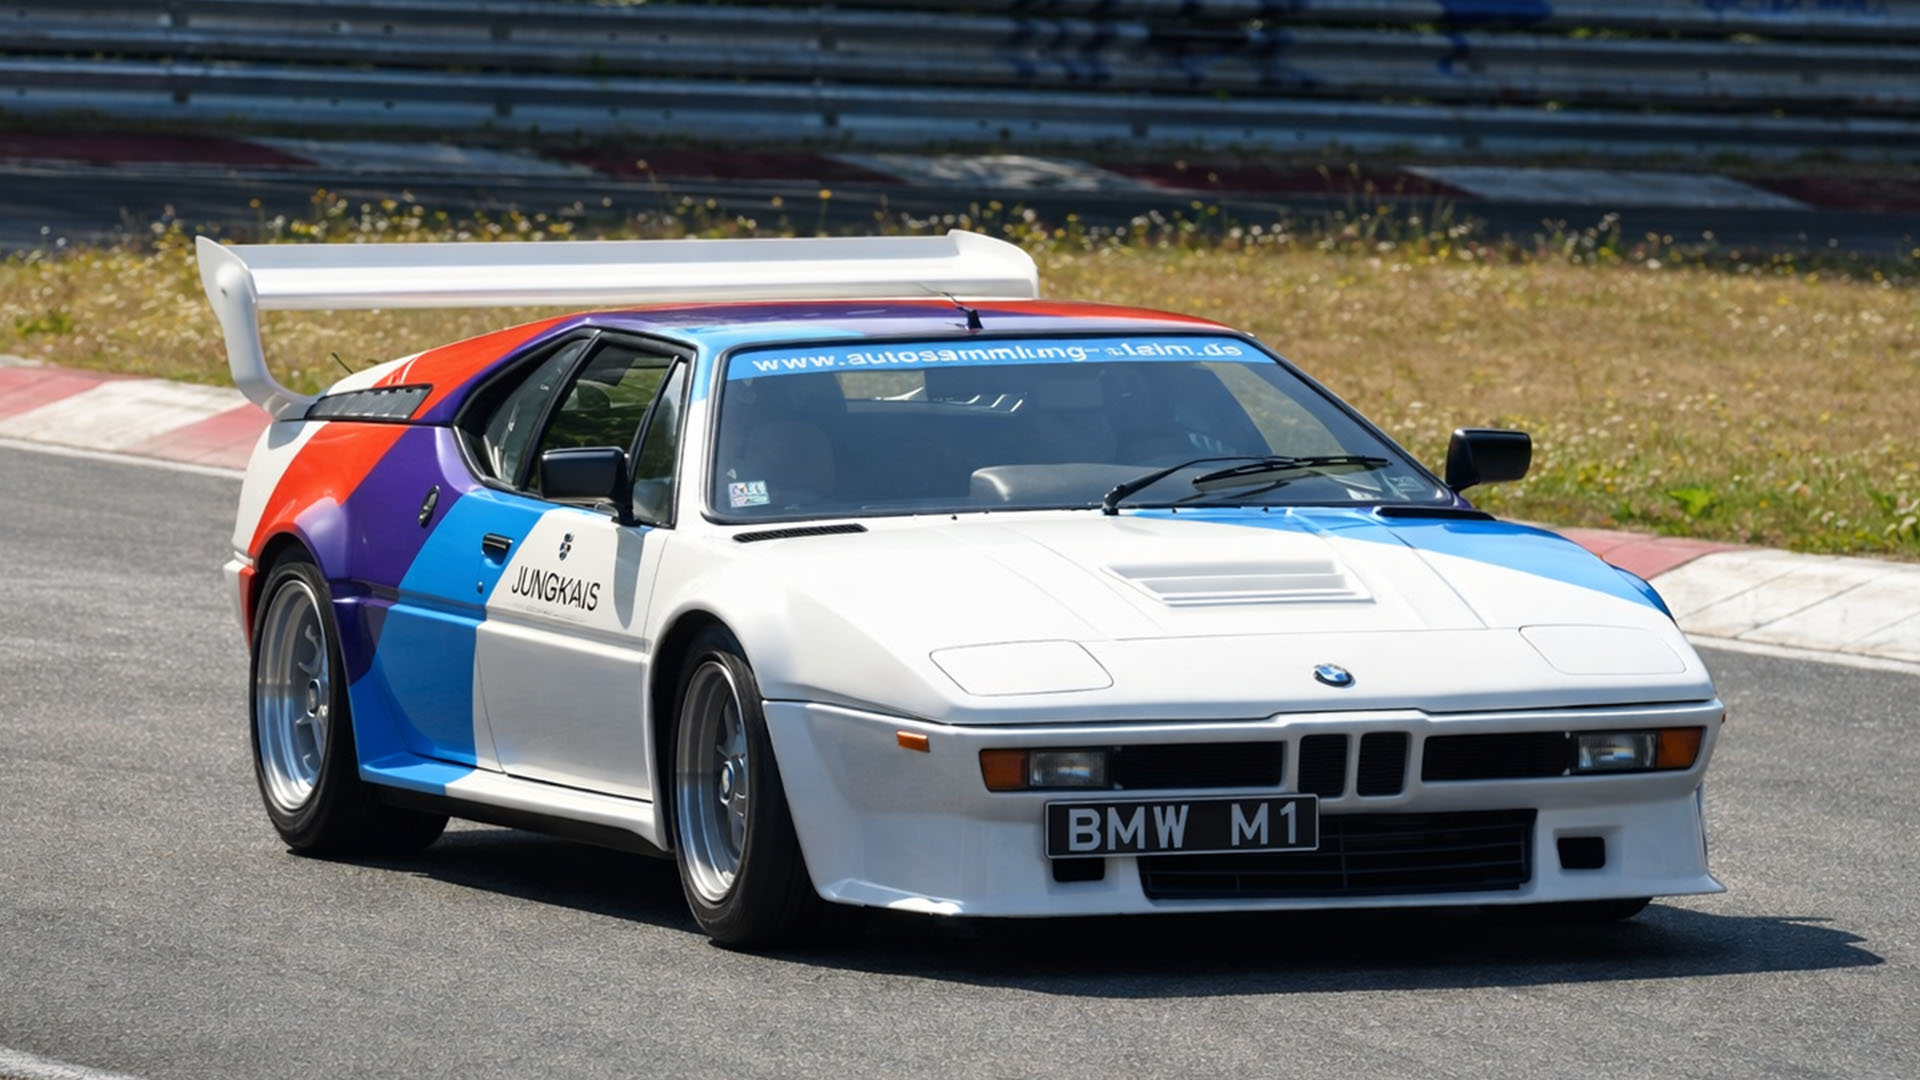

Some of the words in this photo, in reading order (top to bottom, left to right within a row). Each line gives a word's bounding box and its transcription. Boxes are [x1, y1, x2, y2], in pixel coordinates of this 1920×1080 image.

[511, 565, 601, 611] JUNGKAIS
[1068, 804, 1190, 852] BMW
[1231, 801, 1297, 846] M1
